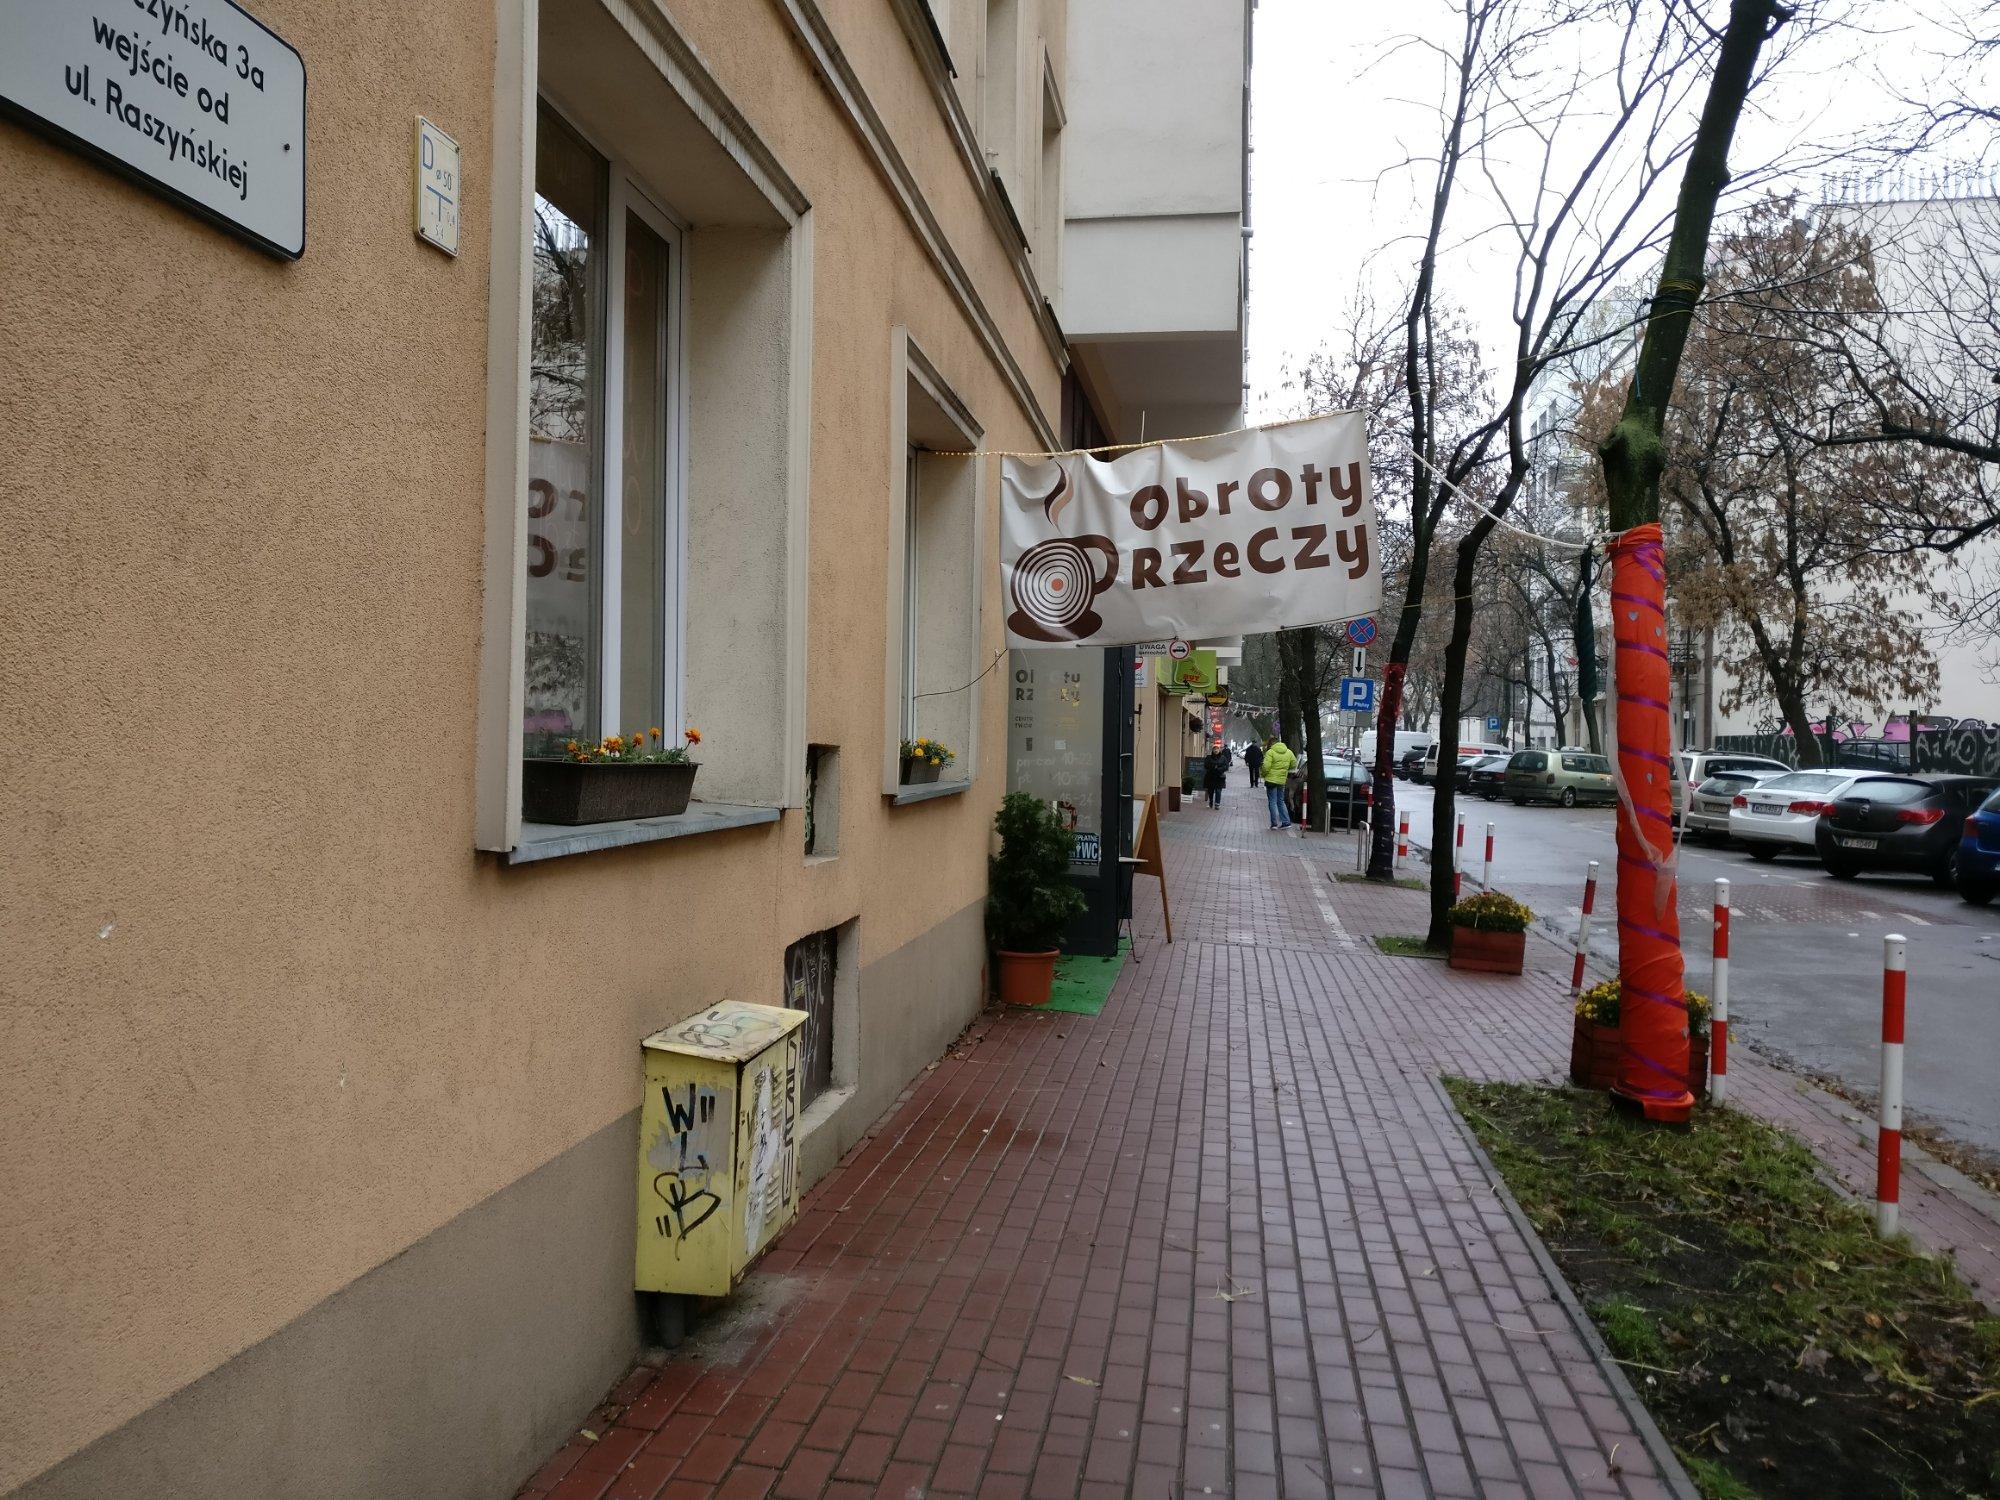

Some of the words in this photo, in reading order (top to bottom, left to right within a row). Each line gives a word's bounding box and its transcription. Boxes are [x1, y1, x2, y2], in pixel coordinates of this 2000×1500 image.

[92, 16, 189, 98] wejście
[196, 86, 229, 125] od
[236, 45, 265, 92] 3a
[65, 64, 97, 106] ul.
[106, 79, 248, 201] Raszyńskiej
[422, 133, 433, 170] D
[1348, 682, 1367, 706] P
[1490, 718, 1498, 728] P
[1081, 842, 1098, 859] WC
